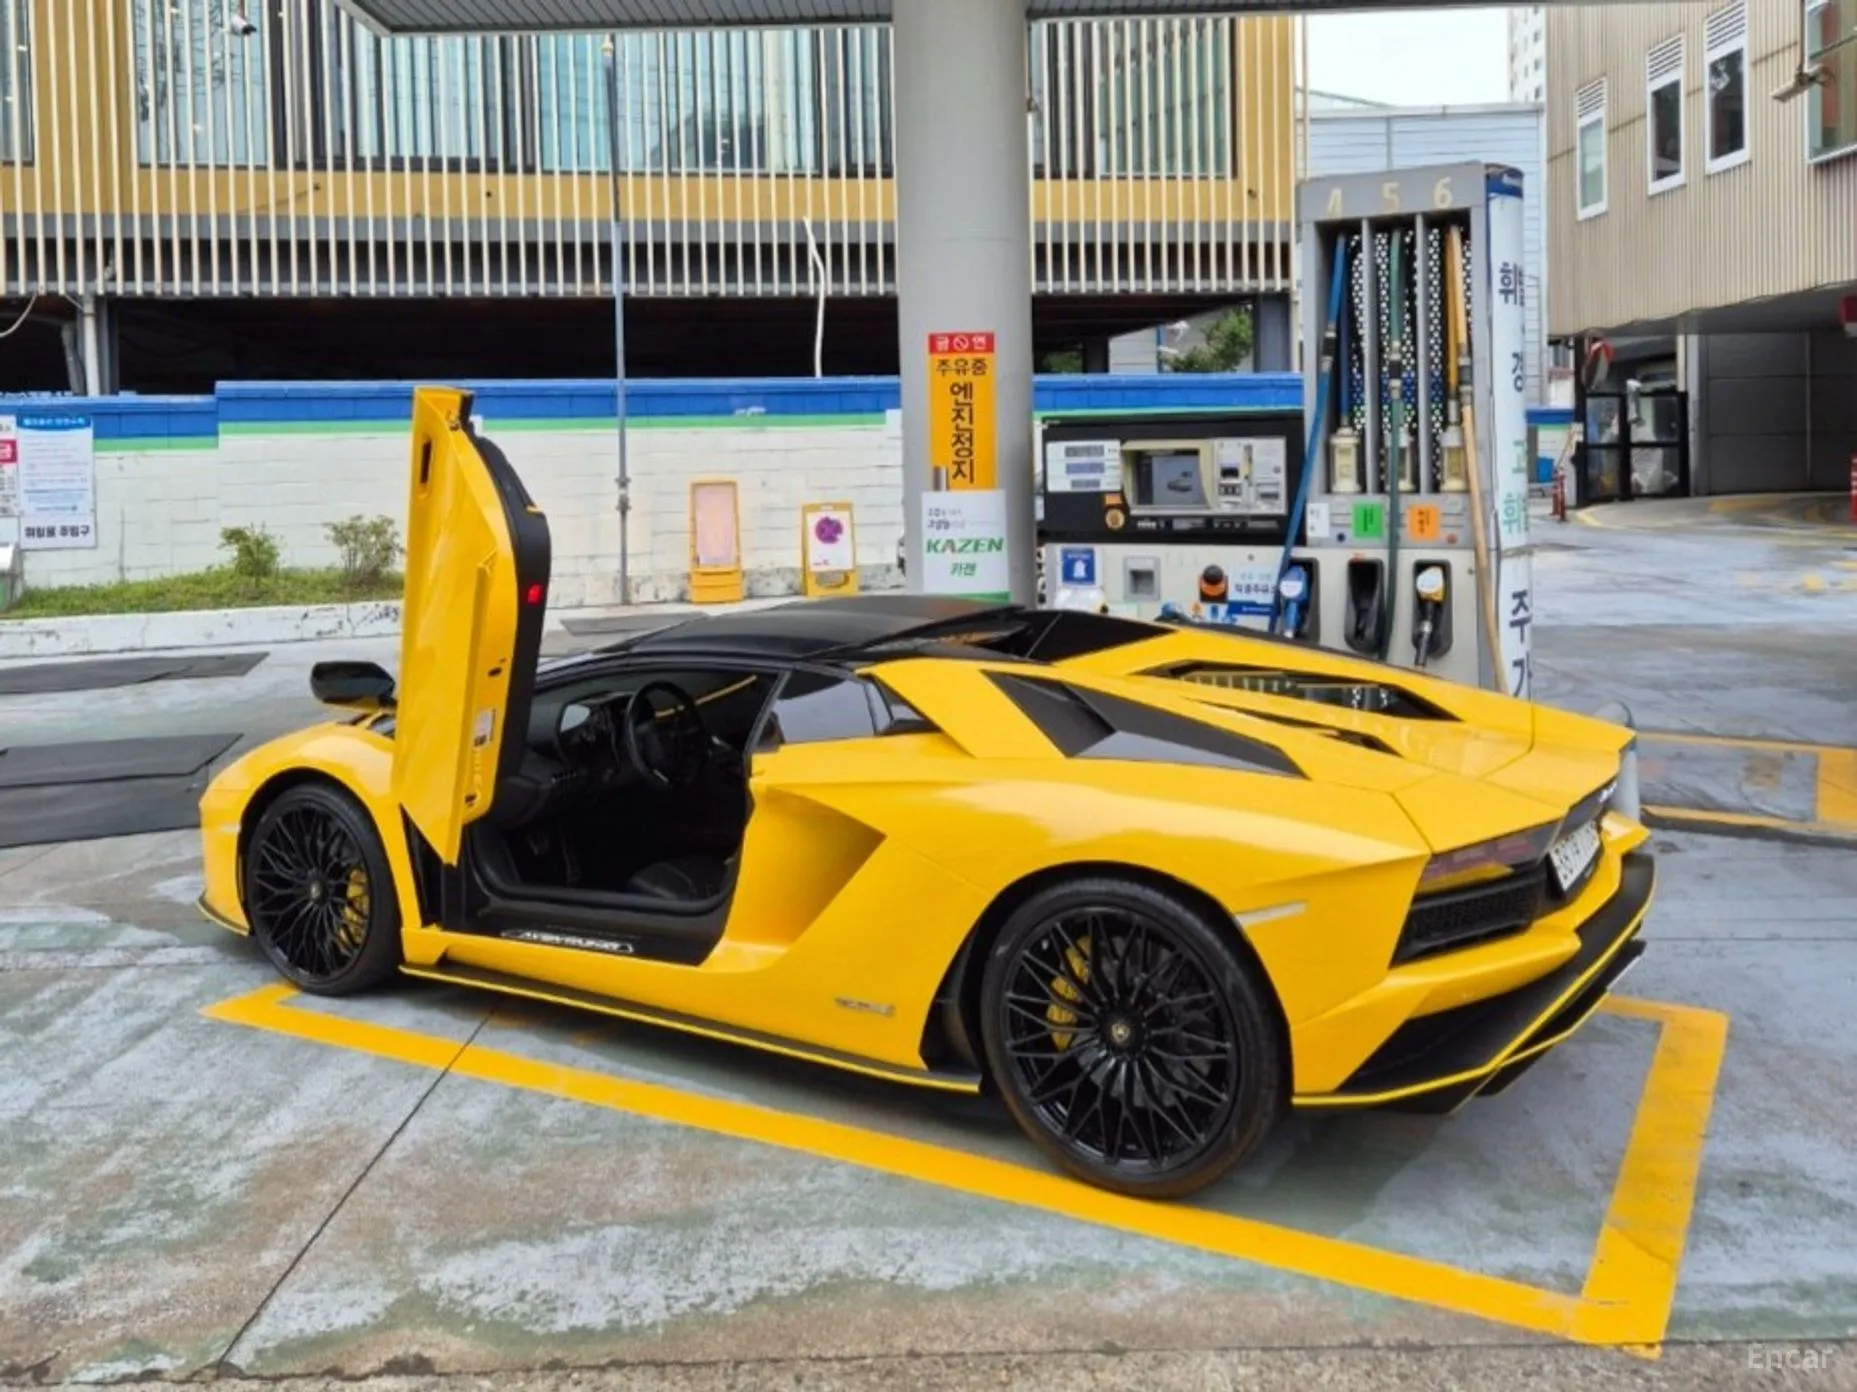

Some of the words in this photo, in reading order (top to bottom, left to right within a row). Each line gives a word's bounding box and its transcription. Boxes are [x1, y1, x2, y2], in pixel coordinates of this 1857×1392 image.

[1327, 187, 1344, 218] 4
[1382, 182, 1400, 212] 5
[1433, 176, 1453, 209] 6
[936, 357, 987, 378] 주유중
[949, 381, 975, 485] 엔진정지
[925, 537, 1005, 554] KAZEN
